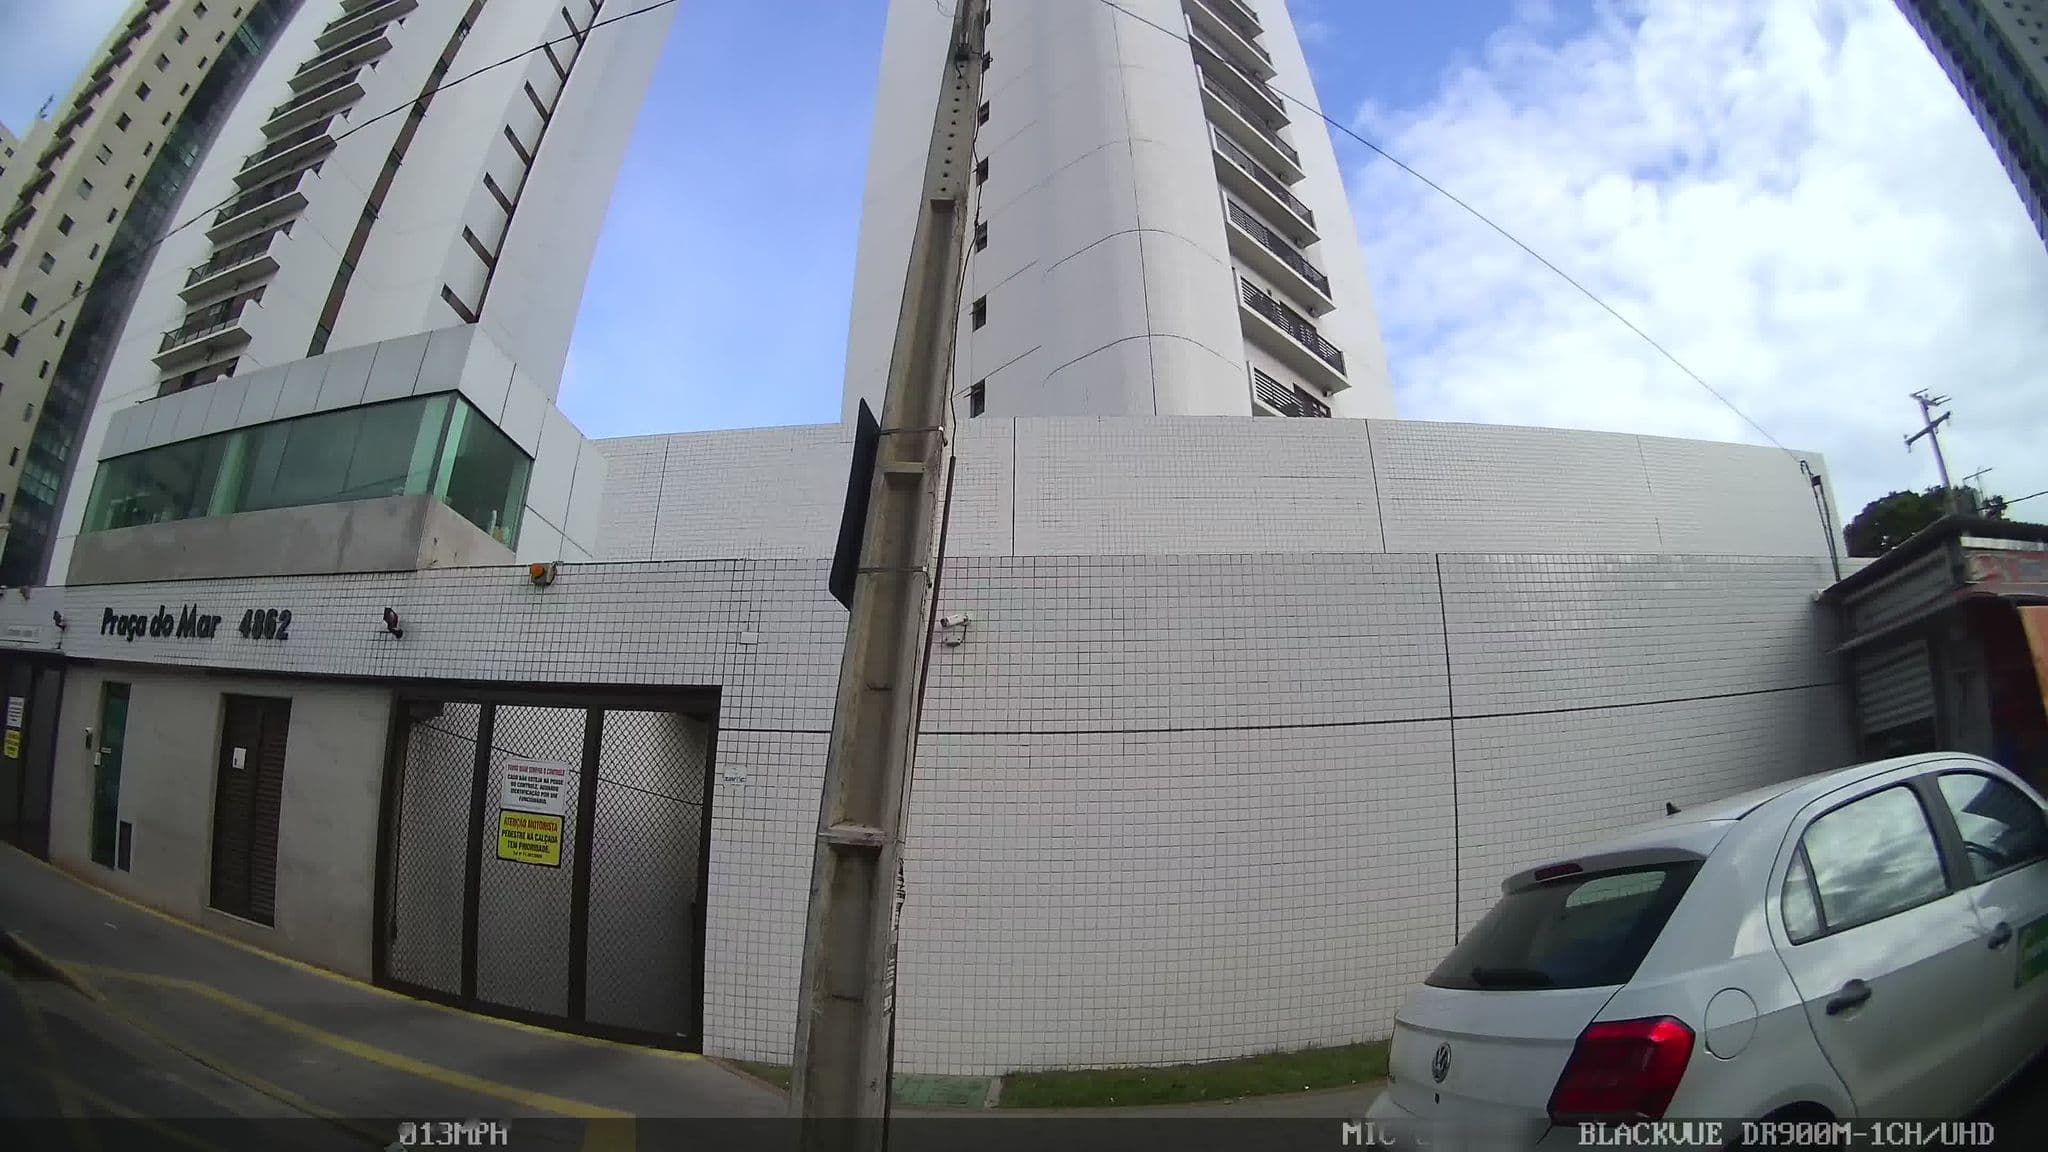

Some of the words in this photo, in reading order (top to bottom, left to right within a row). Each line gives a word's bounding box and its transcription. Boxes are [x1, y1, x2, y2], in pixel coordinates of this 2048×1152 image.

[101, 607, 148, 642] Praça
[150, 604, 174, 637] do
[176, 603, 221, 638] Mar
[504, 817, 527, 828] ATENÇÃO
[528, 820, 557, 831] MOTORISTA
[502, 829, 525, 839] PEDESTRE
[535, 833, 558, 843] CALÇADA
[508, 840, 517, 848] TEM
